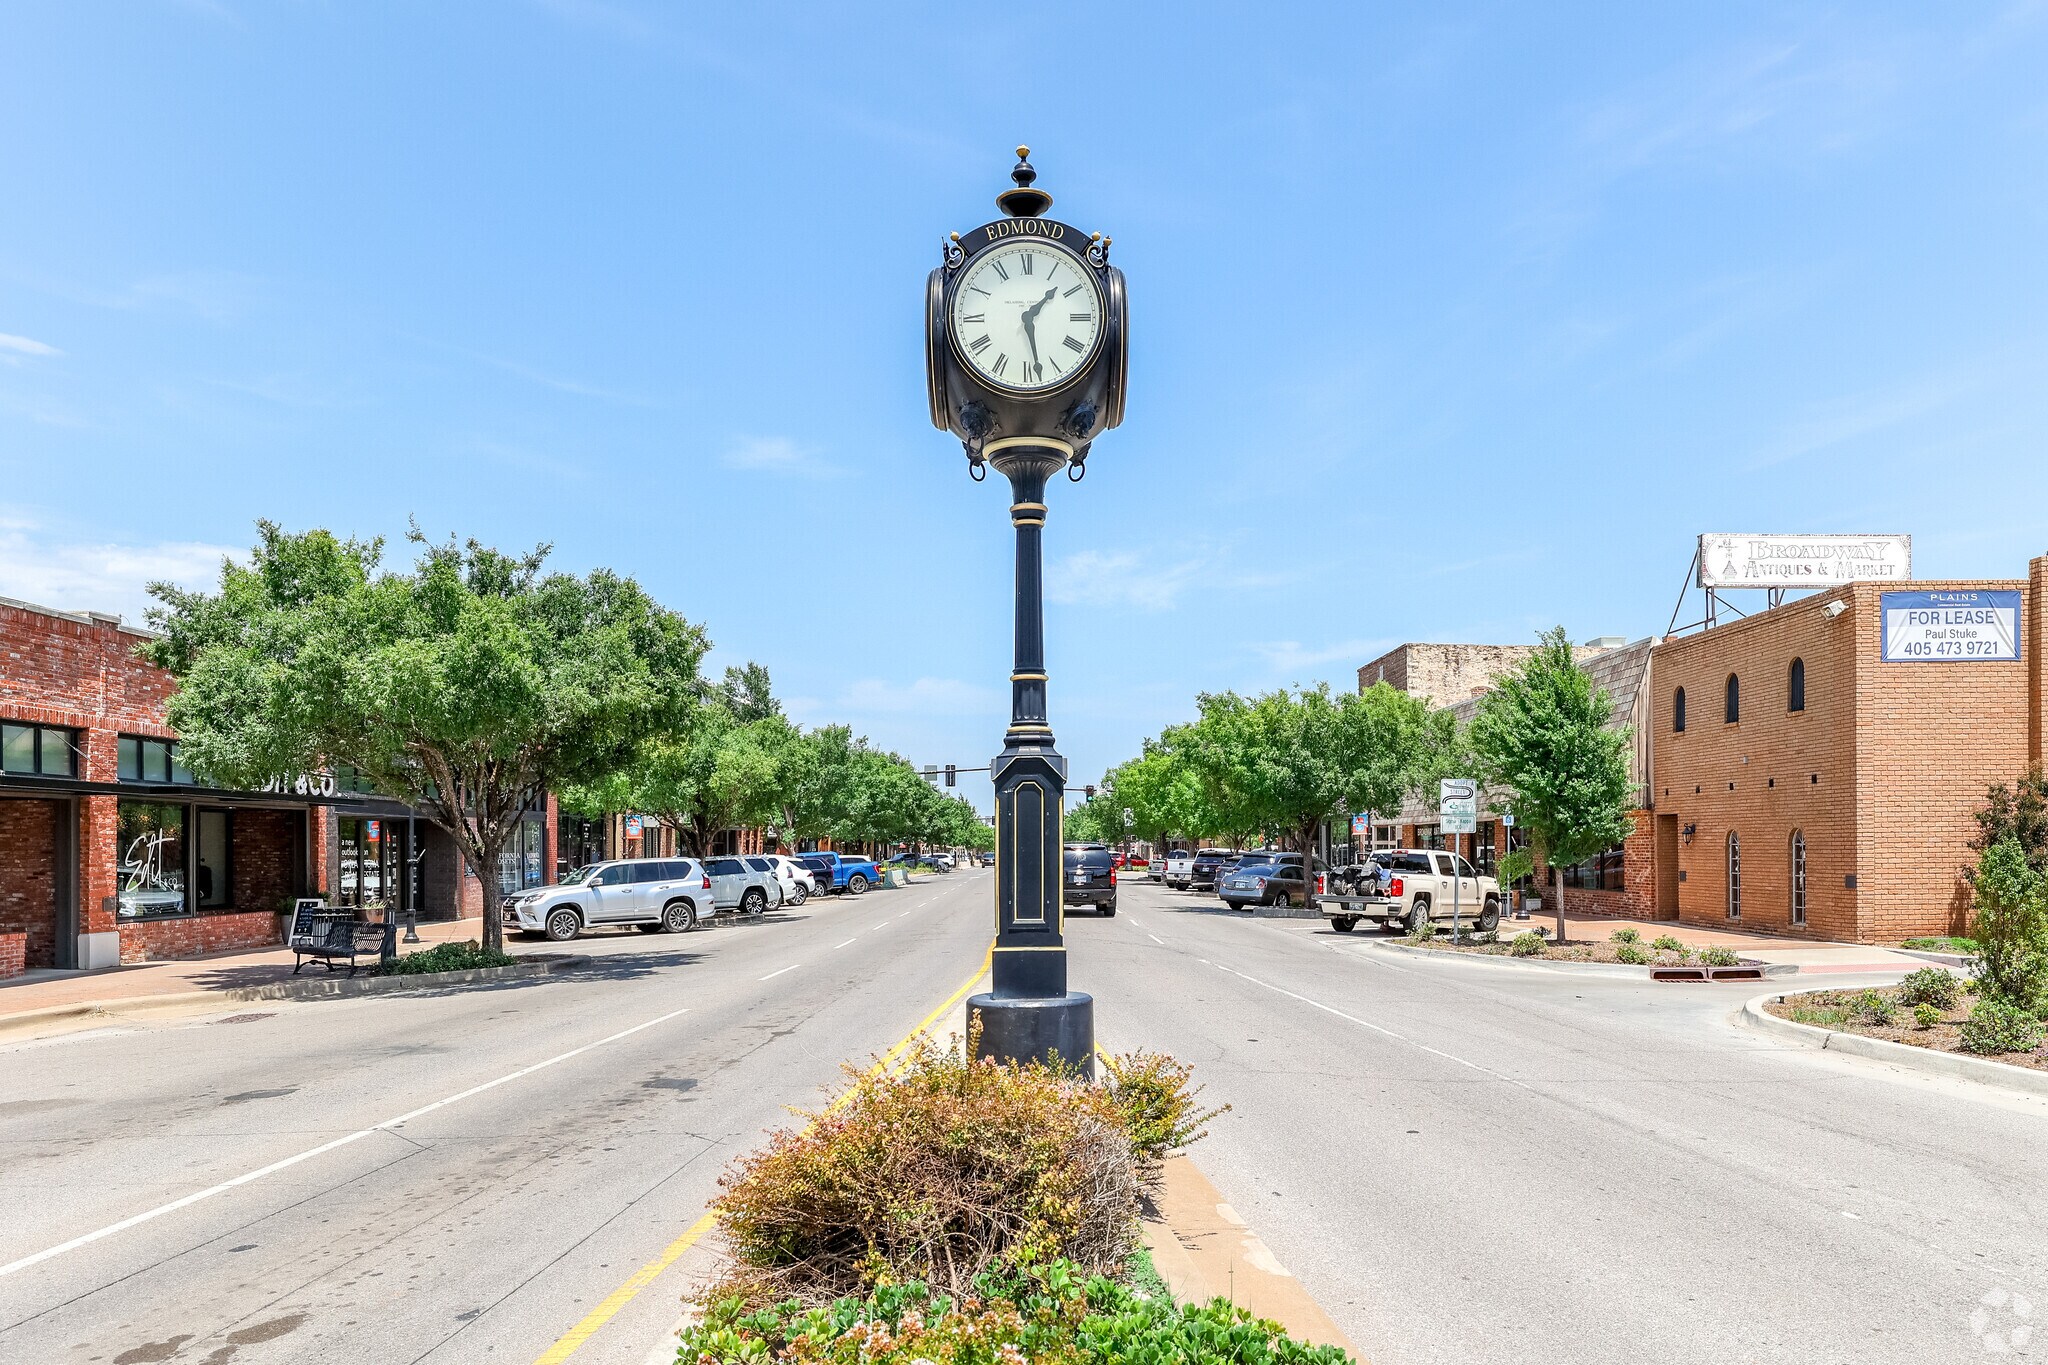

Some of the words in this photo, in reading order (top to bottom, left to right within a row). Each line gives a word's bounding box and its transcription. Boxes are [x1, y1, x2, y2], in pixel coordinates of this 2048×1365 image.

[985, 219, 1064, 241] EDMOND
[1818, 562, 1828, 575] &
[1930, 593, 1978, 601] PLAINS
[1909, 611, 1940, 625] FOR
[1945, 610, 1995, 624] LEASE
[1925, 628, 1946, 639] Paul
[1949, 628, 1978, 639] Stuke
[1904, 642, 1932, 655] 405
[1936, 641, 1962, 655] 473
[1966, 641, 1998, 654] 9721
[341, 847, 358, 856] outlook
[125, 827, 175, 892] Edit
